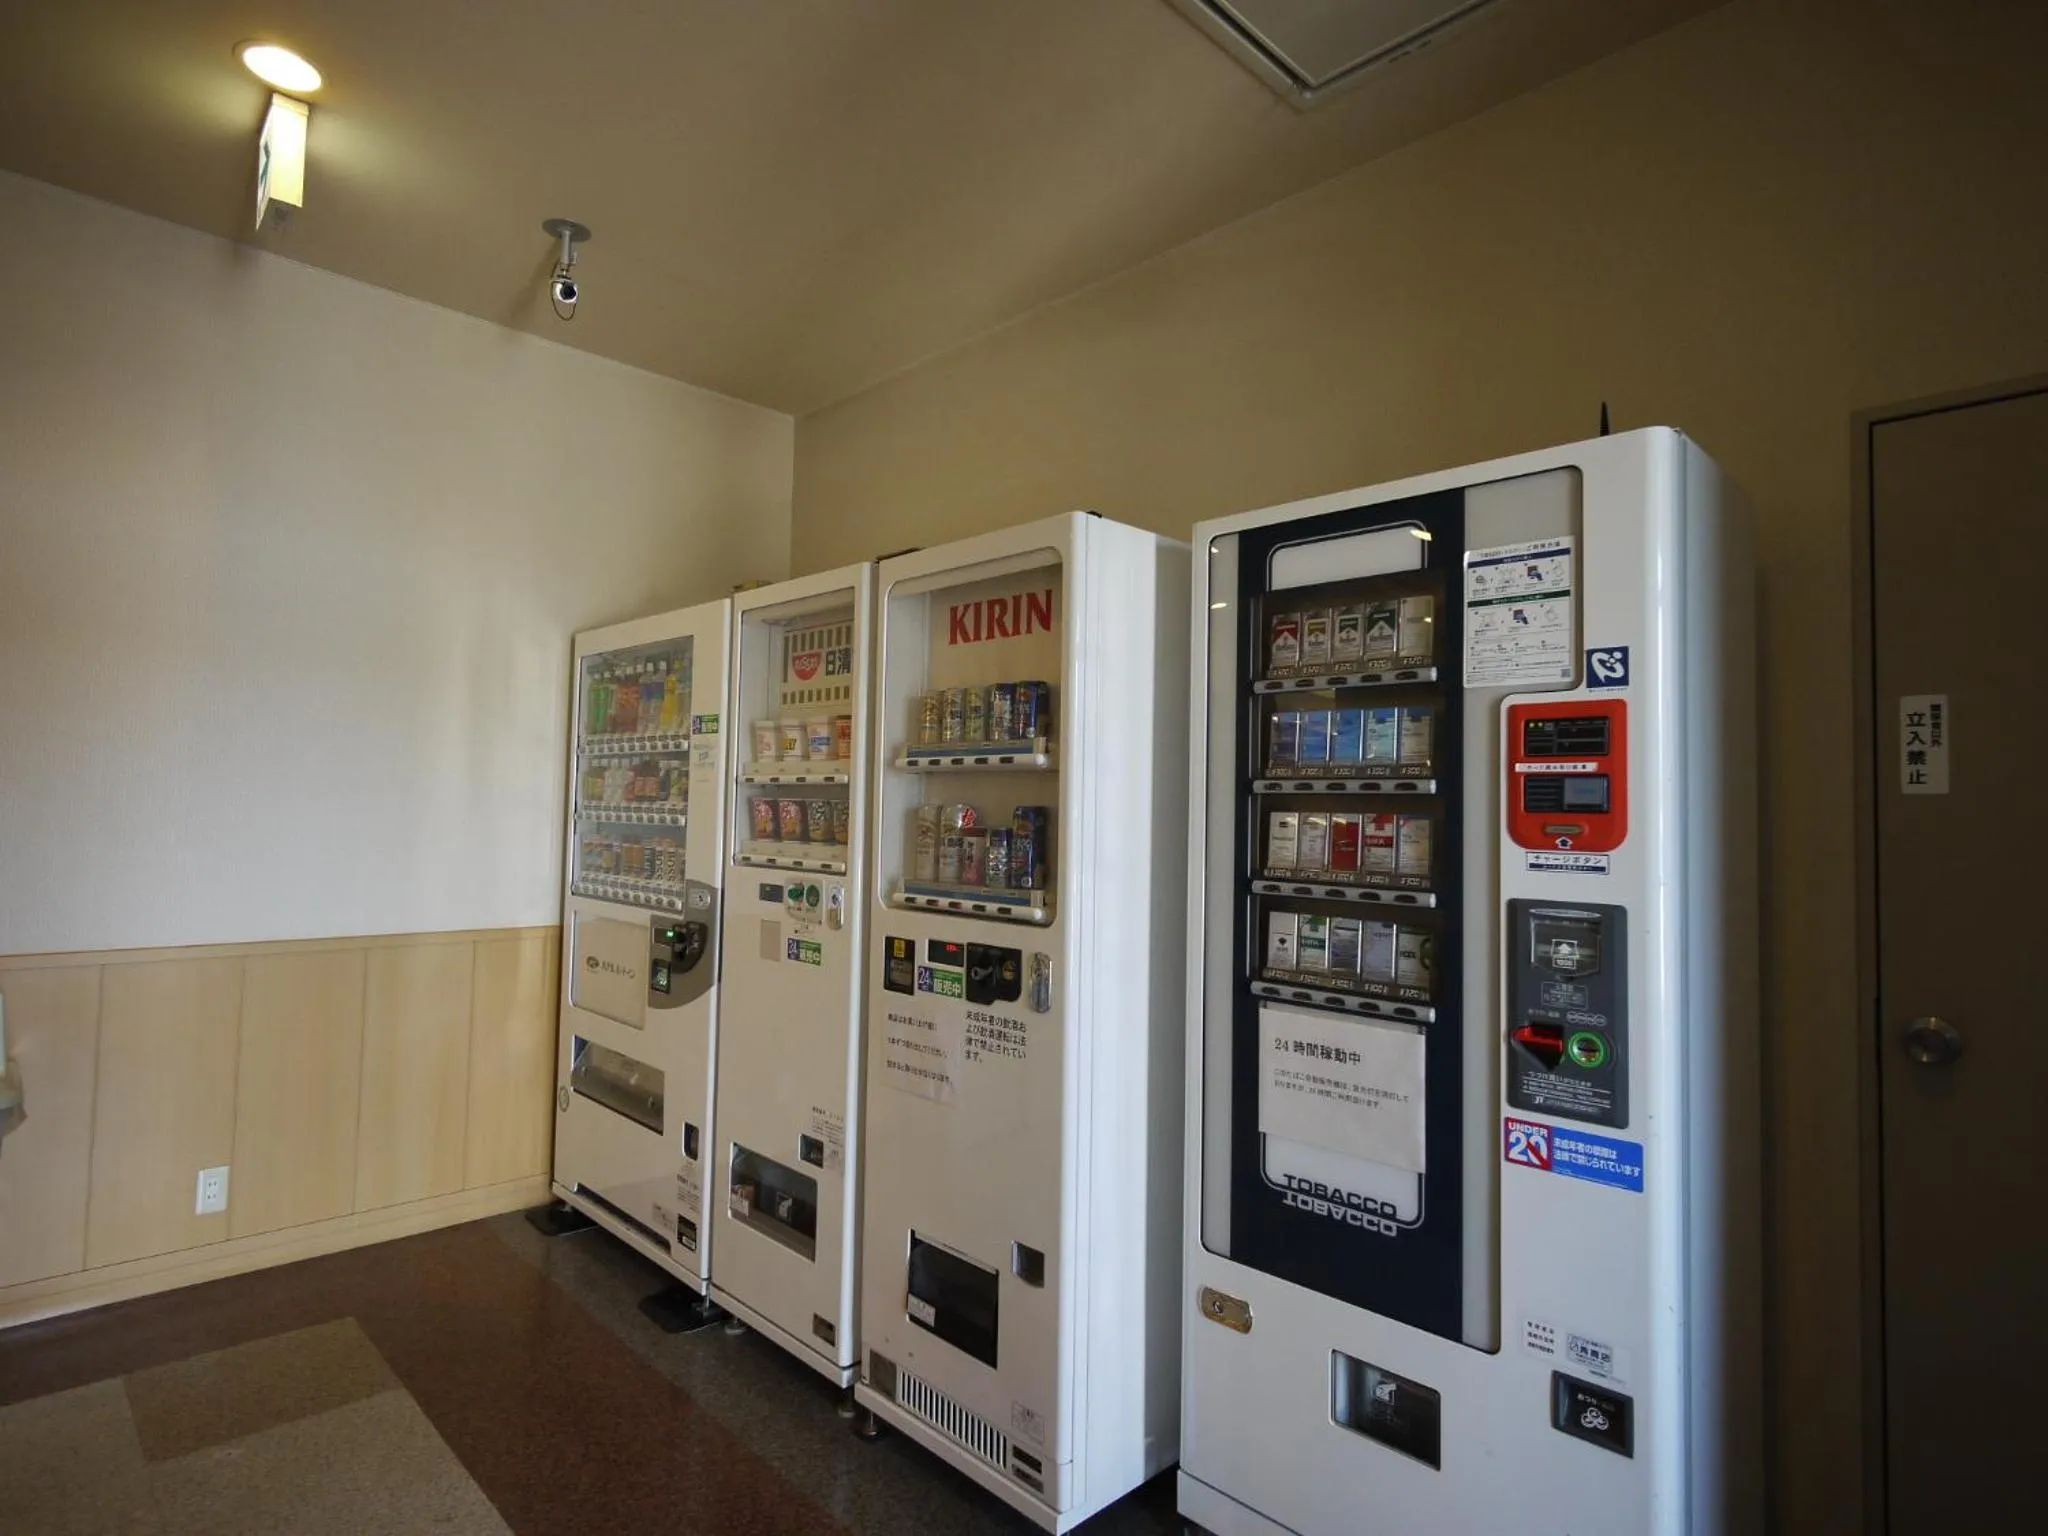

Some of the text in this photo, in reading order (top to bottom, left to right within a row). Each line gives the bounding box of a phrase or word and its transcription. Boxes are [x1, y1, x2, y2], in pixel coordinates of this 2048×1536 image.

[948, 589, 1053, 646] KIRIN
[1906, 711, 1926, 785] 立入禁止
[918, 969, 930, 984] 24
[1508, 1122, 1549, 1138] UNDER
[1508, 1131, 1548, 1166] 20
[1553, 1137, 1618, 1159] 未成年者の喫煙は
[1553, 1150, 1641, 1178] 法律で禁じられています
[1283, 1173, 1397, 1216] TOBACCO
